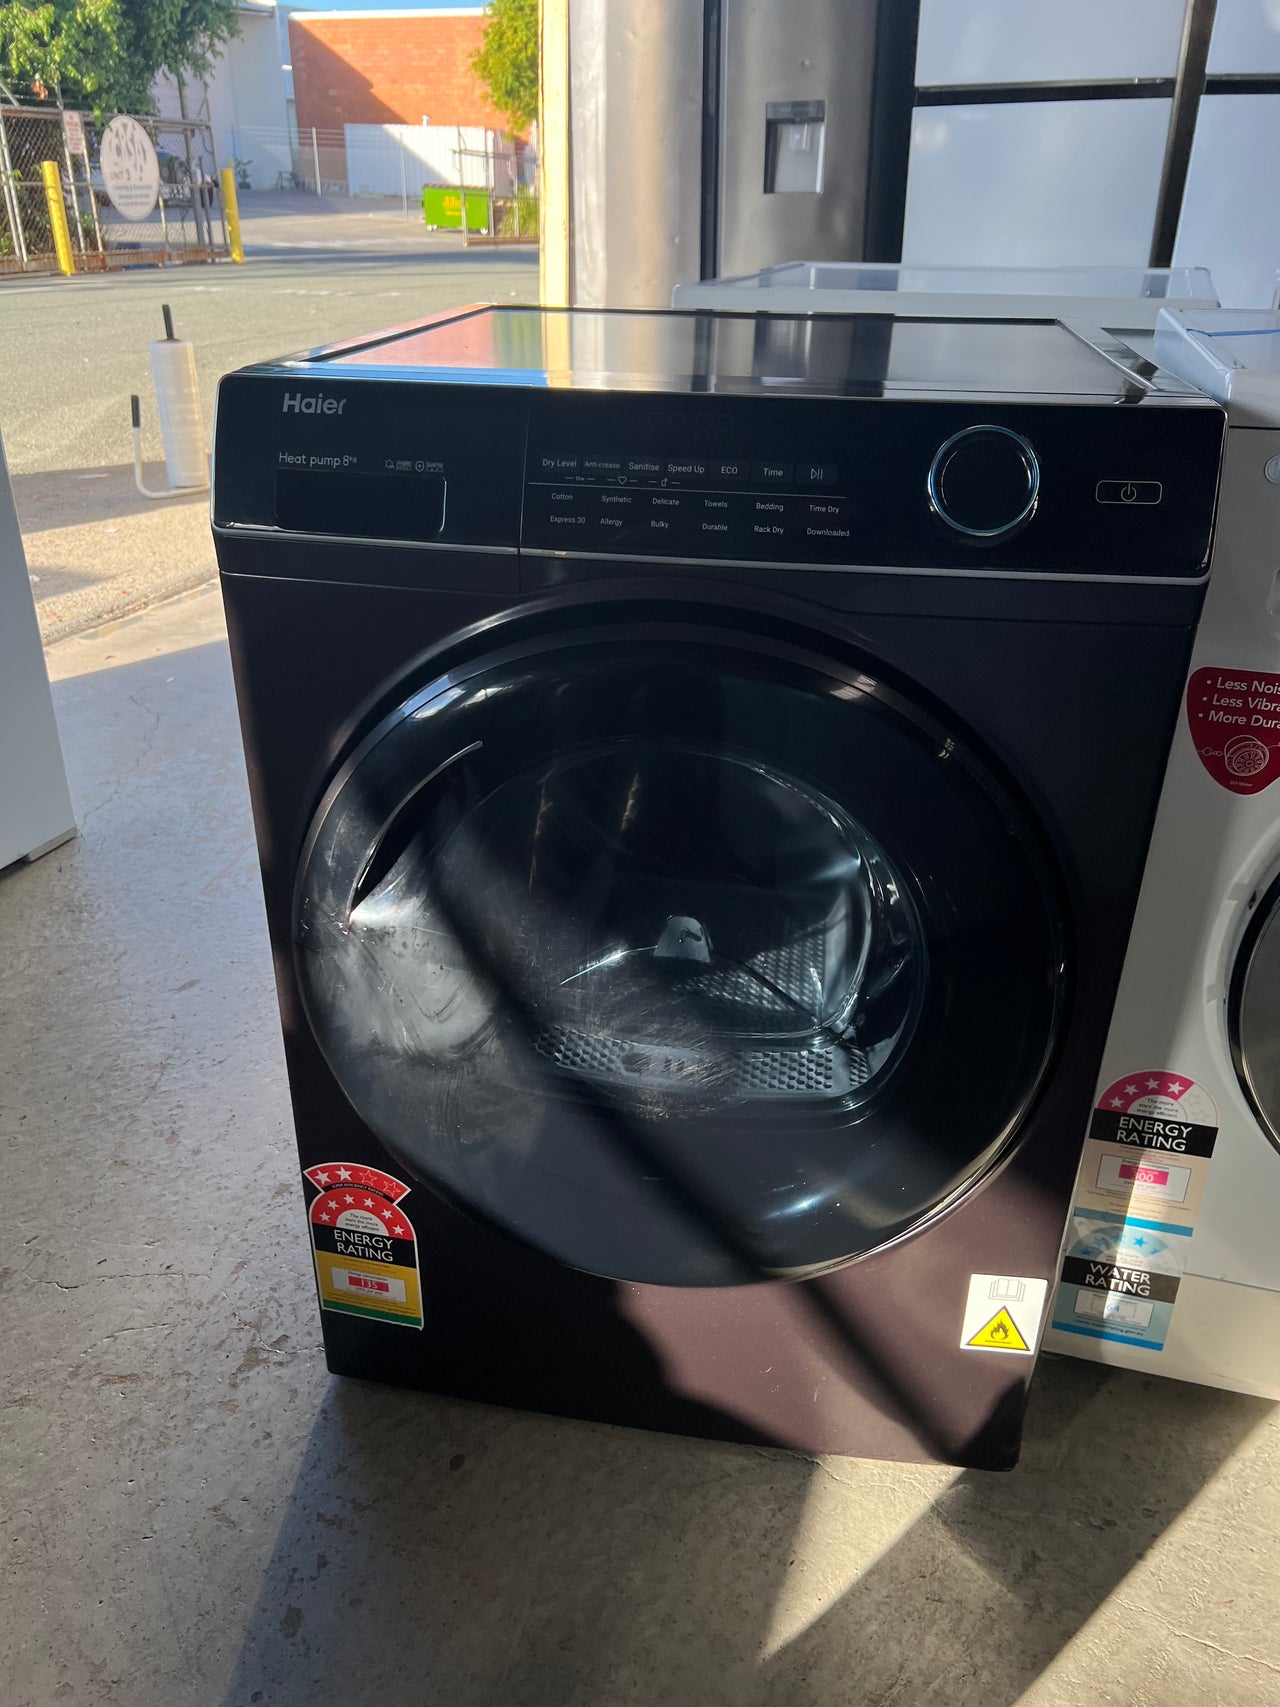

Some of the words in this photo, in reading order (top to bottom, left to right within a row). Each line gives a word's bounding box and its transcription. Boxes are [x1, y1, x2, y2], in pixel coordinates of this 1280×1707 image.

[282, 392, 347, 414] Haier
[278, 452, 307, 464] Heat
[310, 456, 340, 468] pump
[542, 458, 554, 468] Dry
[556, 460, 577, 468] Level
[629, 462, 660, 471] Sanitise
[668, 464, 692, 473] Speed
[694, 466, 705, 474] Up
[720, 466, 738, 475] ECO
[763, 468, 783, 476] Time
[602, 495, 632, 504] Synthetic
[756, 503, 784, 512] Bedding
[828, 506, 839, 514] Dry
[550, 516, 576, 524] Express
[600, 518, 622, 527] Allergy
[650, 521, 669, 529] Bulky
[772, 526, 784, 535] Dry
[807, 528, 850, 536] Downloaded
[1216, 676, 1248, 691] Less
[1213, 693, 1243, 708] Less
[1208, 710, 1247, 725] More
[1119, 1116, 1192, 1138] ENERGY
[1116, 1130, 1187, 1151] RATING
[334, 1230, 393, 1249] ENERGY
[337, 1242, 393, 1262] RATING
[1090, 1262, 1151, 1284] WATER
[361, 1279, 378, 1289] 135
[1085, 1274, 1151, 1296] RATING
